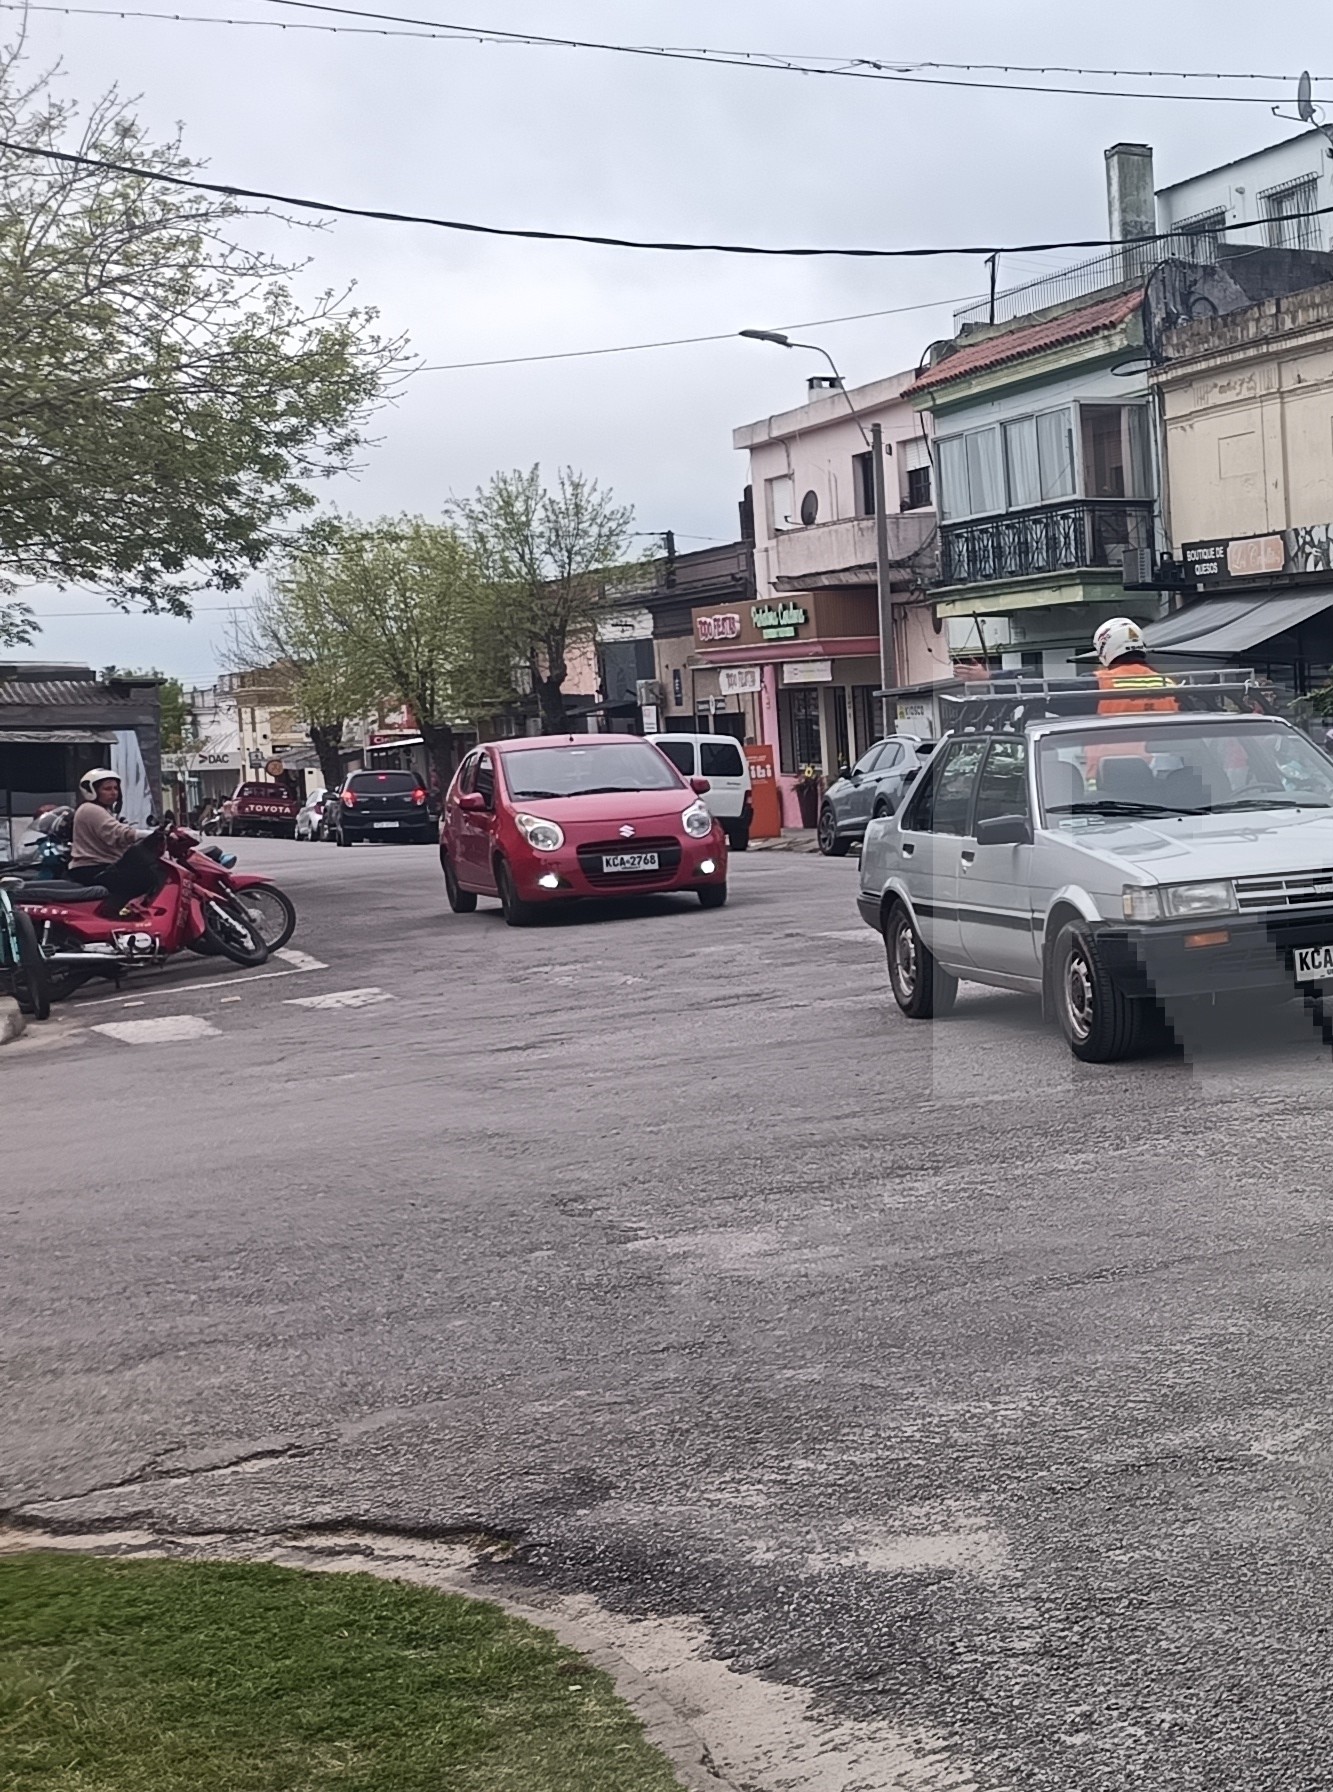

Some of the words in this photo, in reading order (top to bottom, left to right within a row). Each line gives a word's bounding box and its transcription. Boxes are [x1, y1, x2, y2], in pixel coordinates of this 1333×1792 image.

[1186, 548, 1214, 562] BOUTIQUE
[1216, 547, 1224, 557] DE
[1195, 562, 1218, 575] QUESOS
[208, 753, 229, 764] DAC
[250, 804, 291, 814] TOYOTA
[605, 857, 626, 867] KCA
[629, 854, 656, 866] 2768
[1299, 948, 1333, 972] KCA
